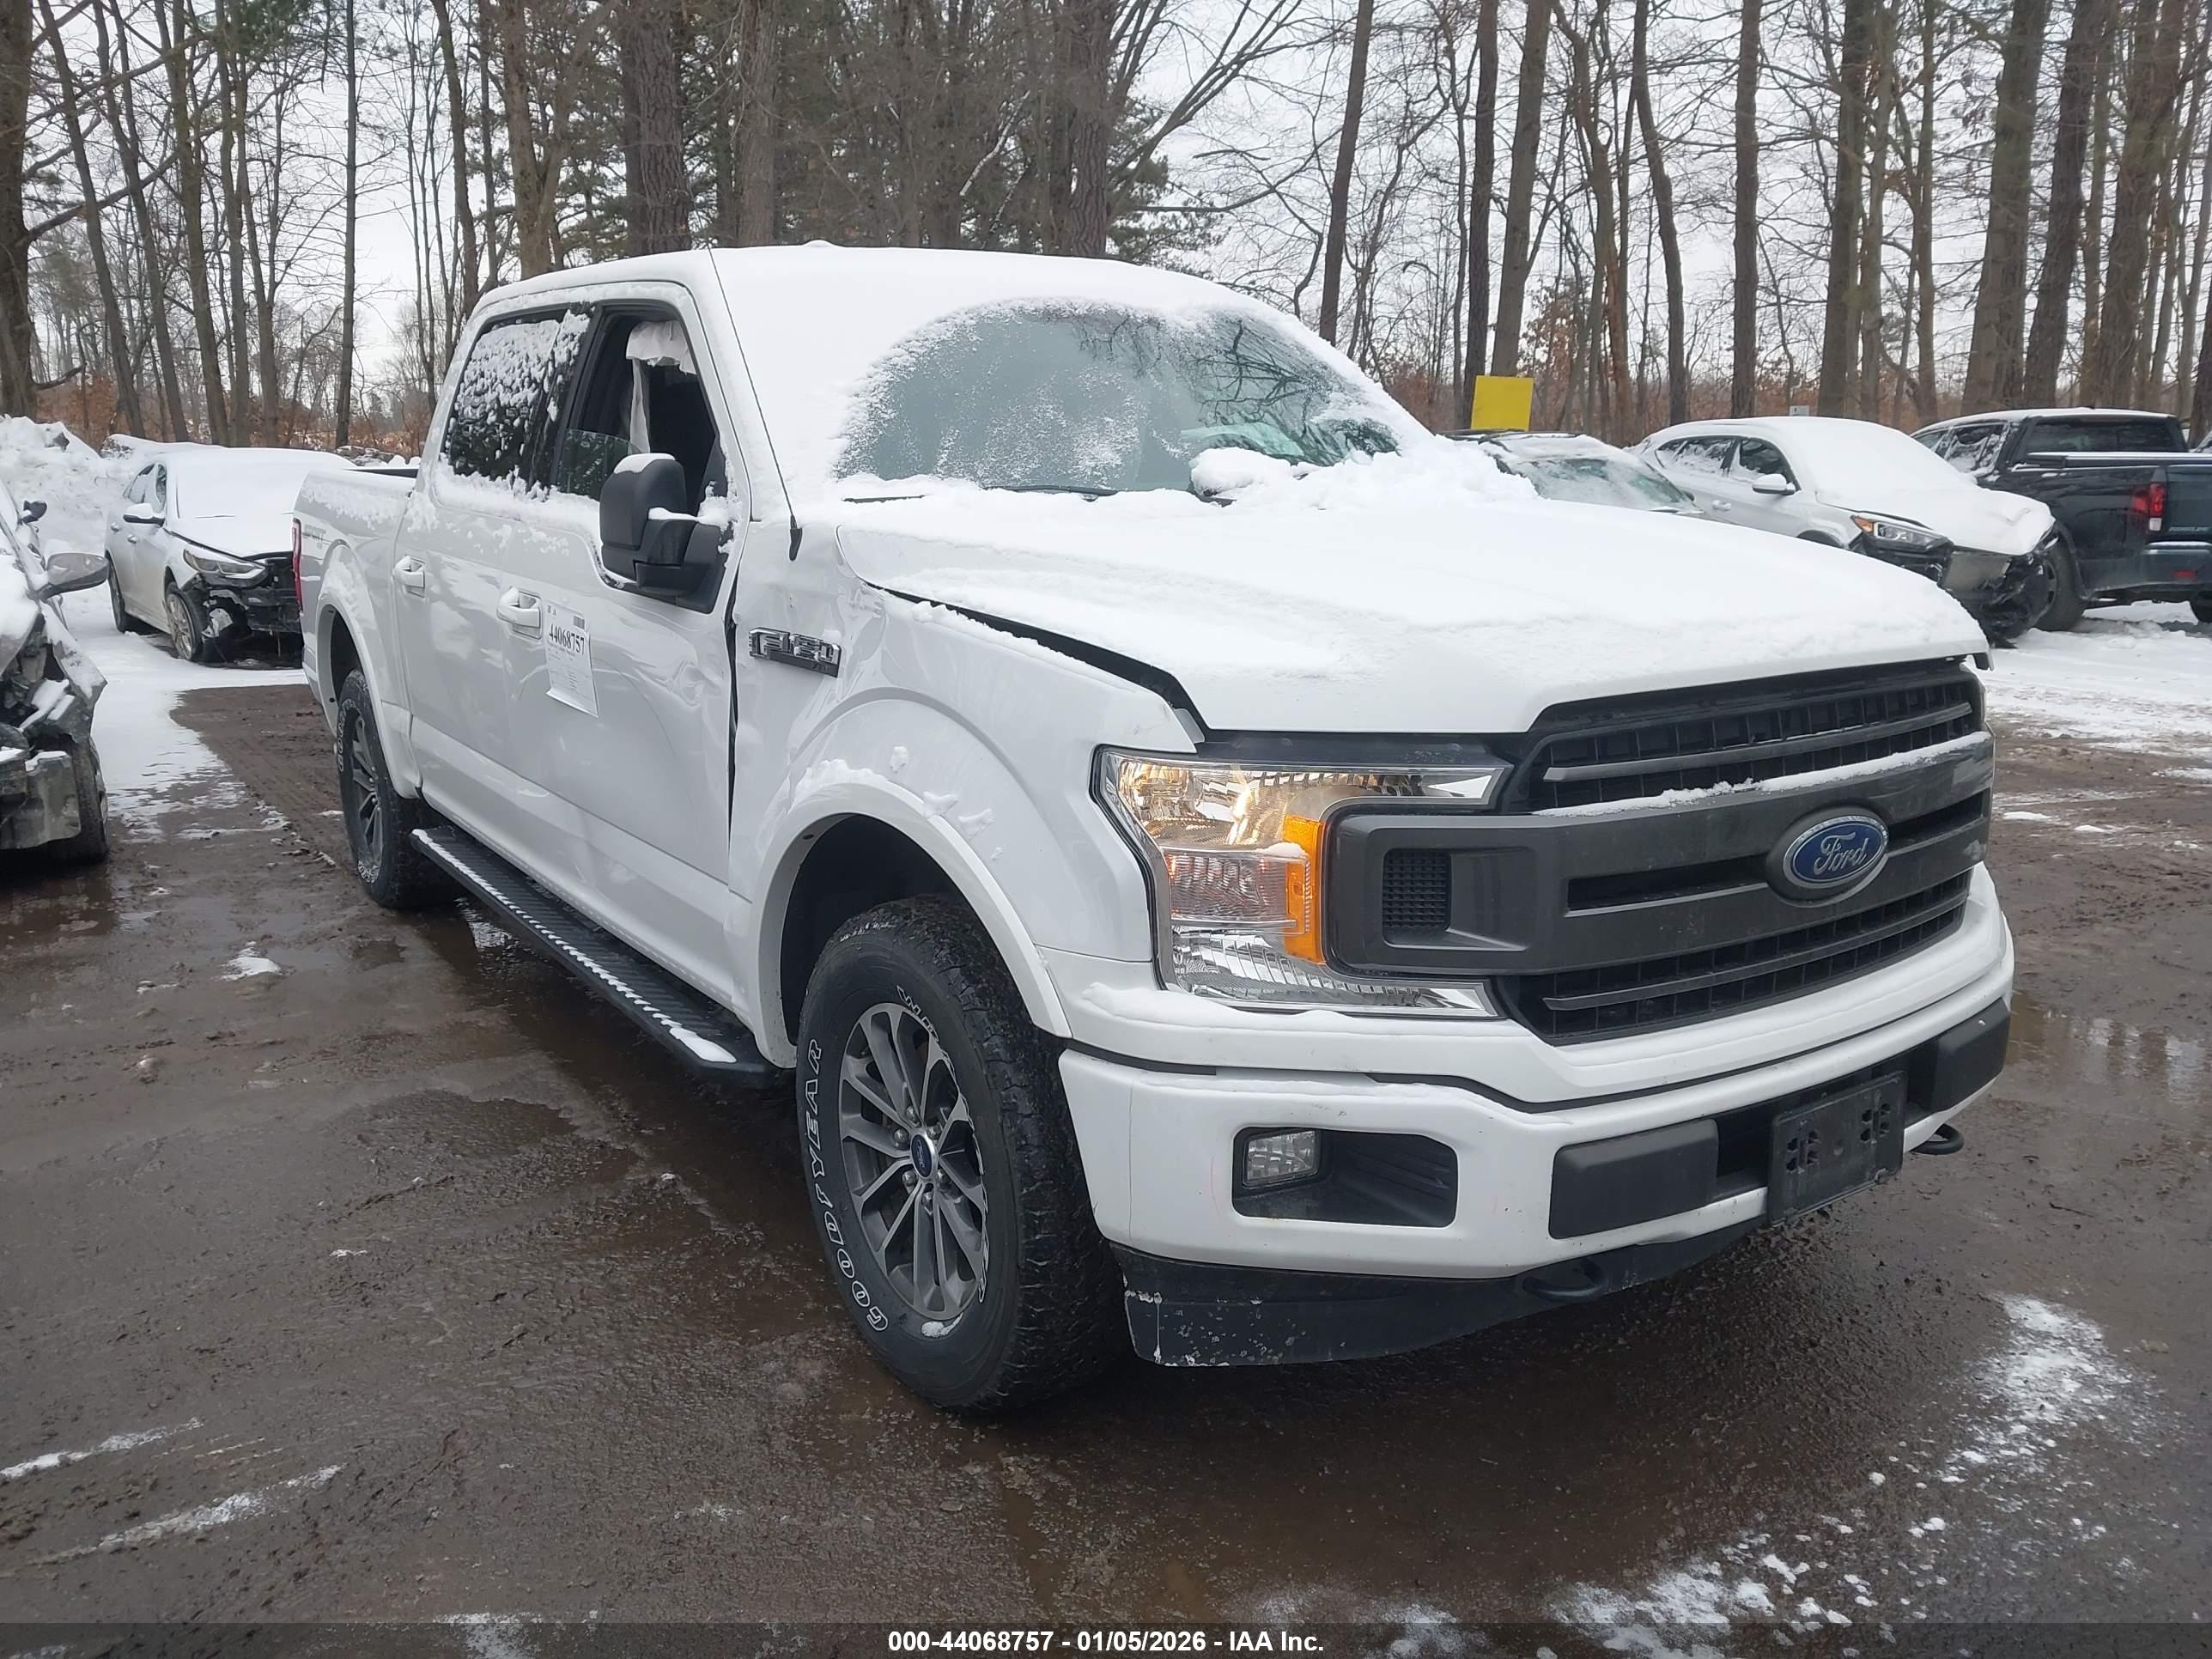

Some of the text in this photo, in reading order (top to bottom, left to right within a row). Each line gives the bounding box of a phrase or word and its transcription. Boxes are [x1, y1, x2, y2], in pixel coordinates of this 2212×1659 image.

[549, 623, 585, 656] 44068757
[1813, 831, 1869, 875] Ford
[804, 1038, 890, 1333] GOODYEAR
